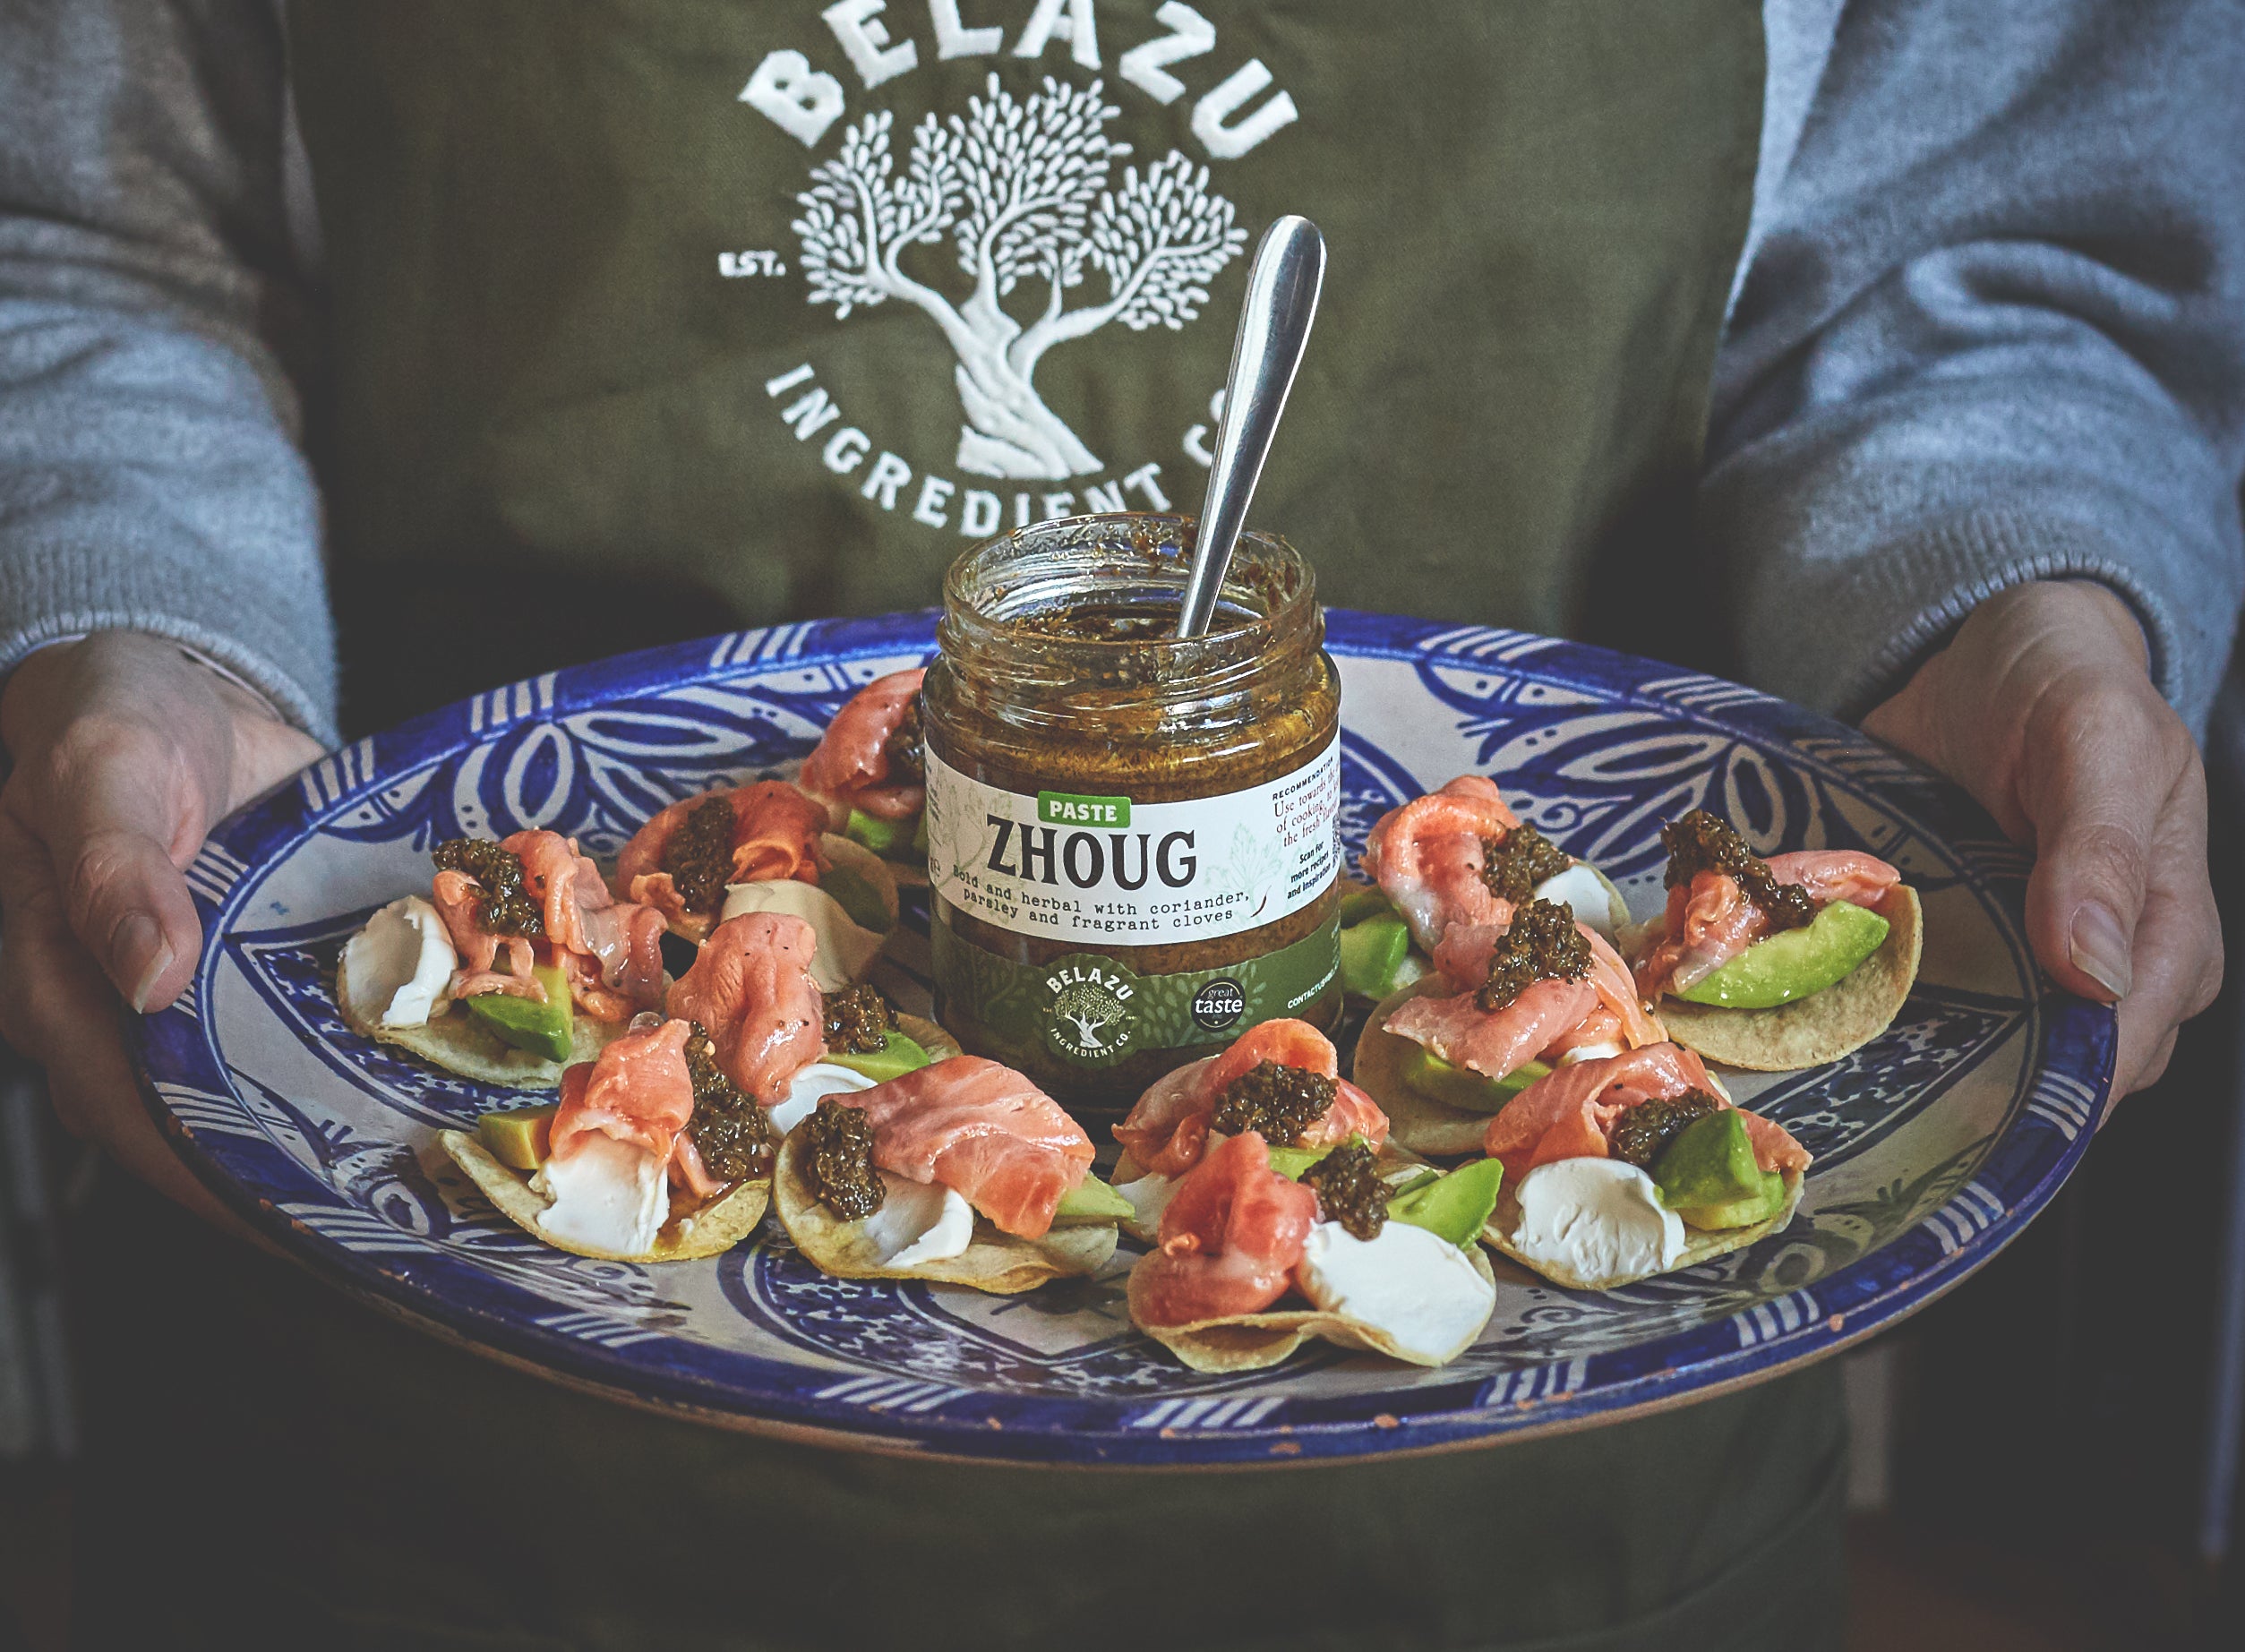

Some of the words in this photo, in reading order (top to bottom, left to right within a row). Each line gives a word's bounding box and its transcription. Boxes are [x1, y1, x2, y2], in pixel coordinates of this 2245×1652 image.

[738, 0, 1298, 158] BELAZU
[718, 250, 786, 277] EST.
[767, 363, 1173, 536] INGREDIENT
[1183, 389, 1225, 467] C
[1050, 800, 1118, 822] PASTE
[1274, 800, 1294, 817] Use
[1298, 777, 1325, 806] towards
[1277, 816, 1287, 834] of
[1291, 800, 1324, 826] cooking
[1284, 831, 1298, 847] the
[1303, 815, 1320, 837] fresh
[987, 813, 1196, 890] ZHOUG
[1299, 849, 1314, 864] Scan
[1315, 842, 1324, 852] for
[953, 864, 978, 887] Bold
[987, 883, 1011, 900] and
[1022, 891, 1082, 912] herbal
[1094, 903, 1137, 915] with
[1150, 892, 1249, 914] coriander,
[1291, 868, 1308, 883] more
[1288, 885, 1301, 899] and
[964, 888, 1019, 919] parsley
[1030, 911, 1058, 925] and
[1072, 916, 1160, 932] fragrant
[1173, 910, 1232, 928] cloves
[1046, 967, 1134, 1000] BELAZU
[1208, 989, 1233, 999] great
[1195, 998, 1243, 1014] taste
[1050, 1028, 1114, 1057] INGREDIENT
[1116, 1031, 1131, 1047] CO.
